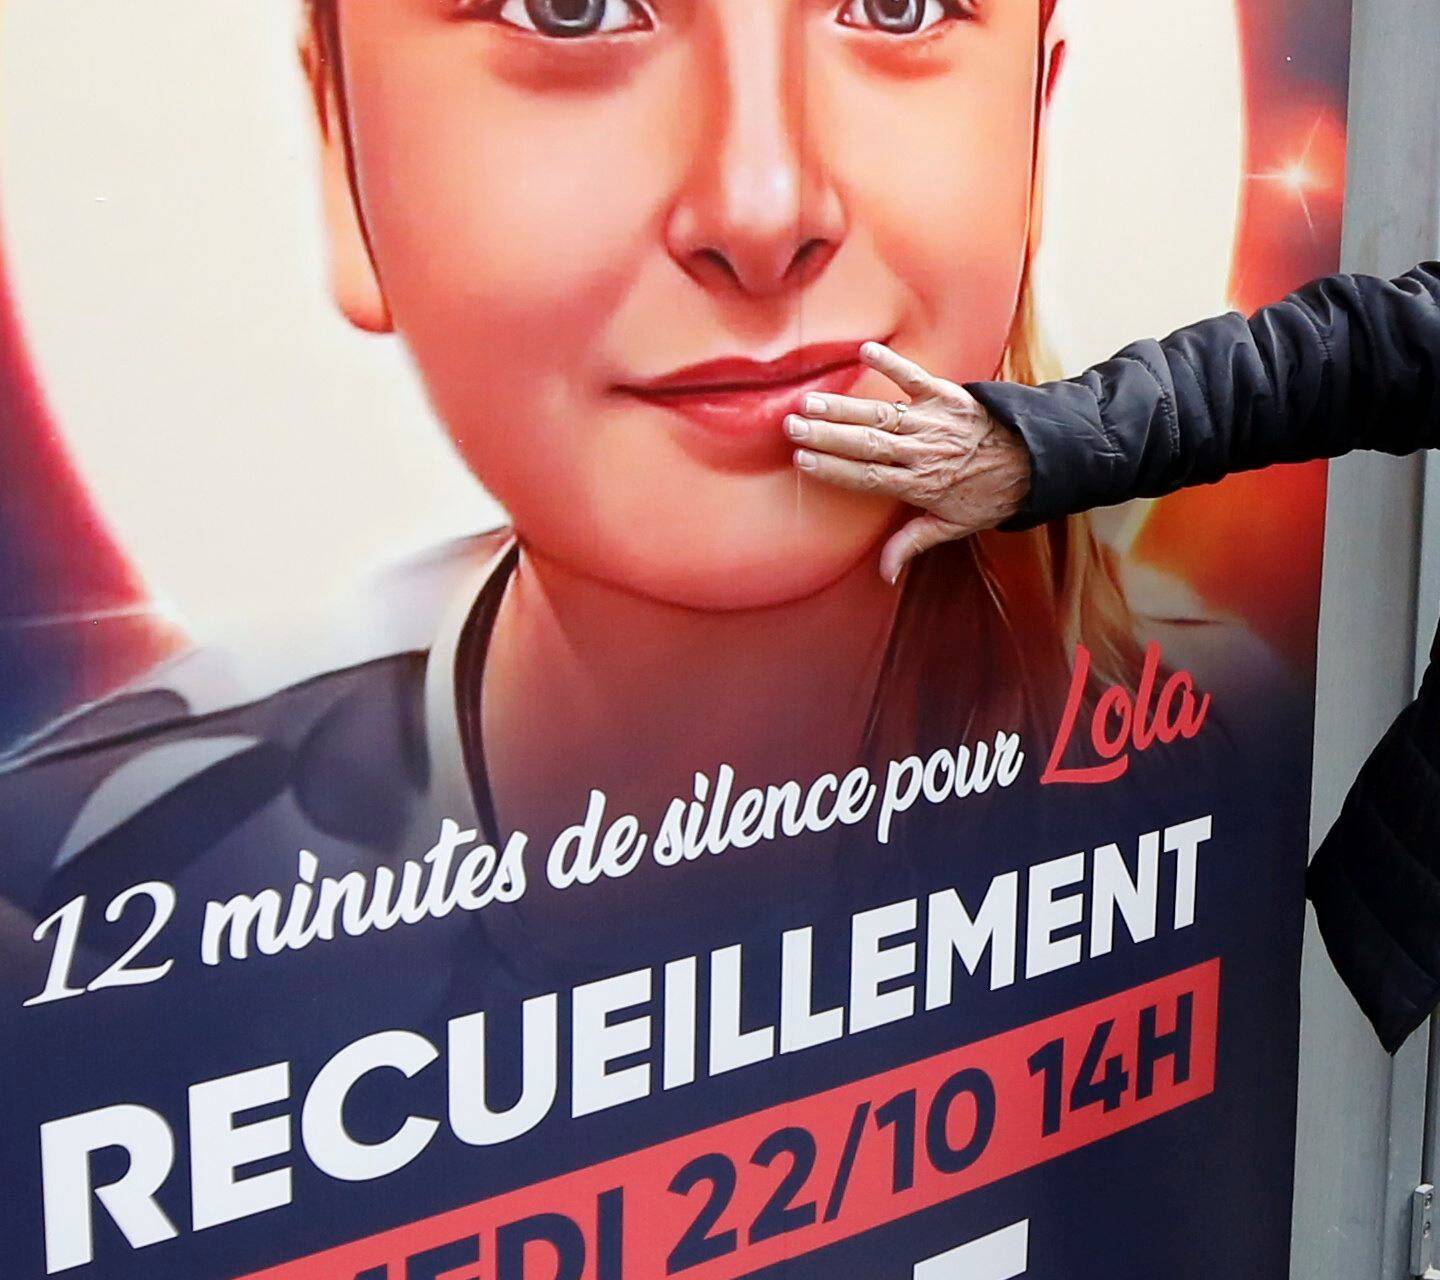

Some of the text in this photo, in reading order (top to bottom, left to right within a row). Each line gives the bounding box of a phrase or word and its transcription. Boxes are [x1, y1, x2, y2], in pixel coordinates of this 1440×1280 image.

[22, 640, 1211, 1007] 12 minutes de silence pour Lola
[38, 815, 1214, 1276] RECUEILLEMENT
[663, 1064, 998, 1278] 22/10
[1026, 986, 1197, 1137] 14H
